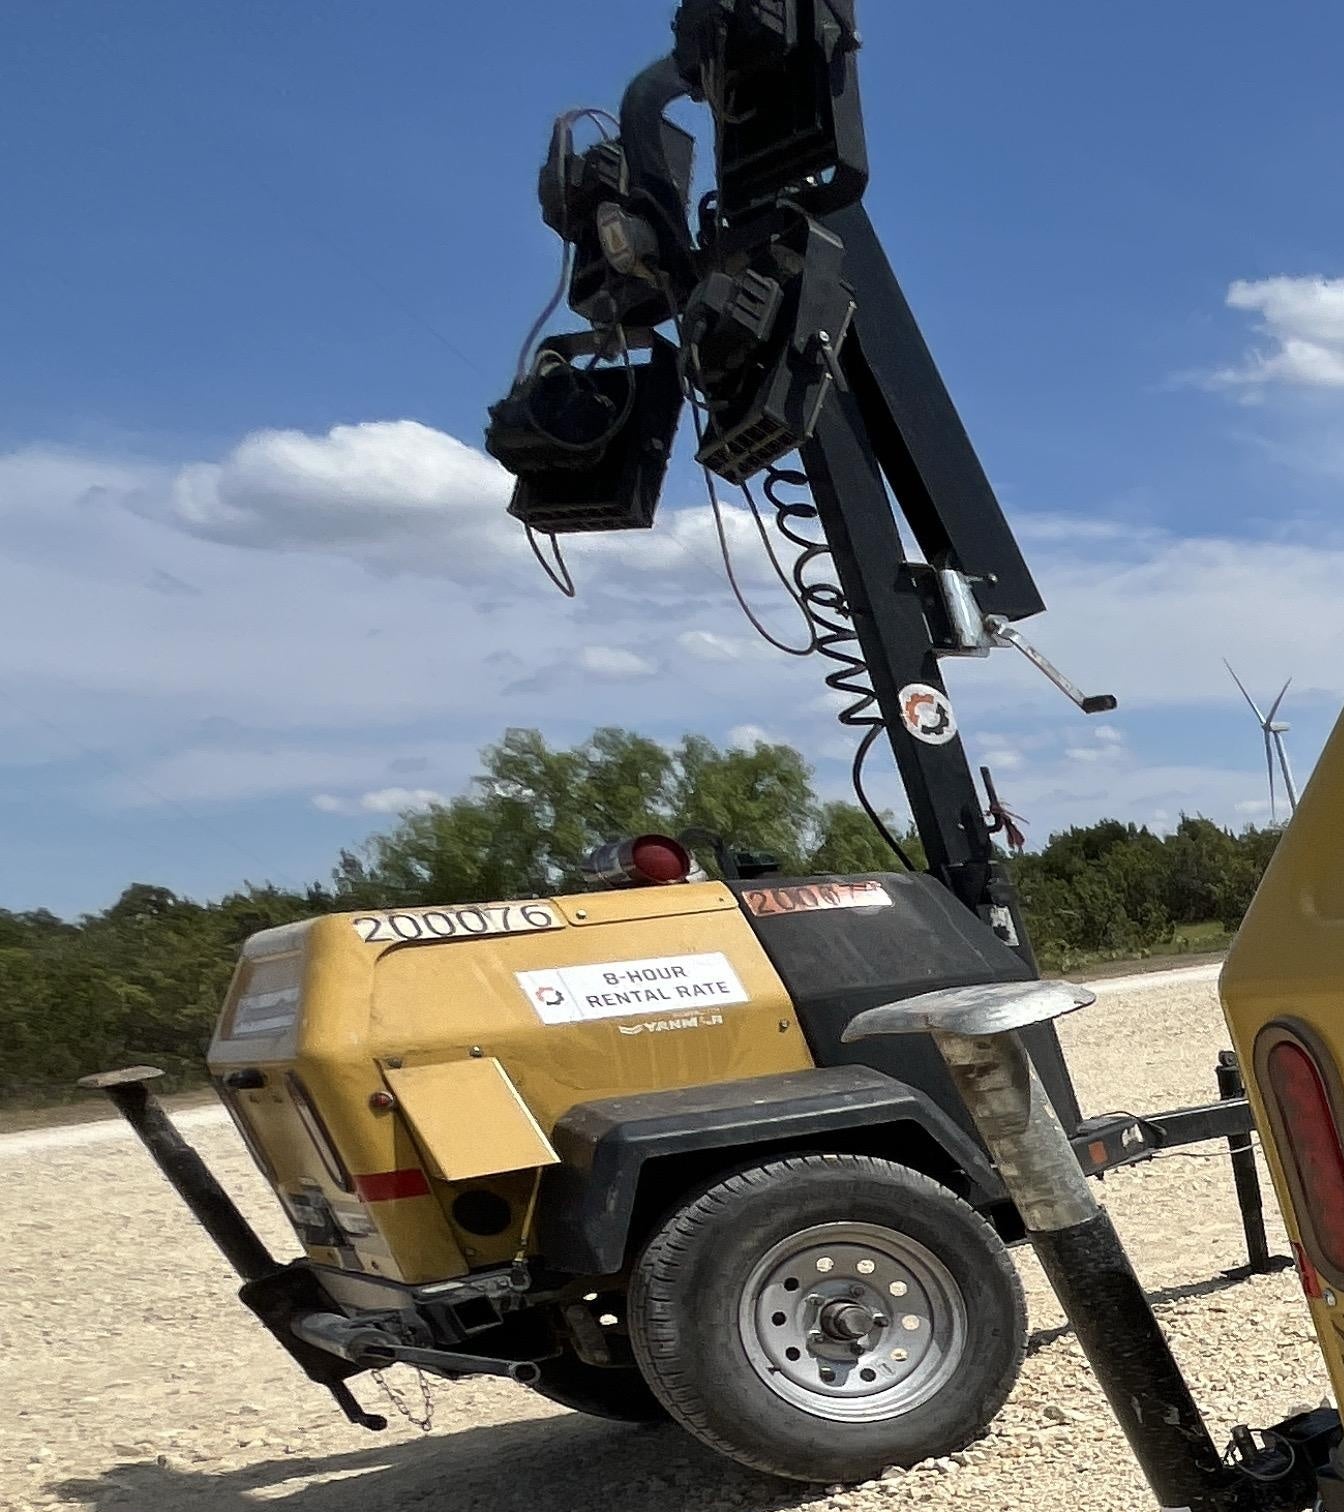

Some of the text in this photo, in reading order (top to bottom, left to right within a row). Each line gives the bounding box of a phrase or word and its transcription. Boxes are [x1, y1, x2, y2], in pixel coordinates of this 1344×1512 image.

[353, 904, 553, 944] 200076
[602, 965, 688, 987] 8-HOUR
[584, 980, 731, 1009] RENTAL RATE
